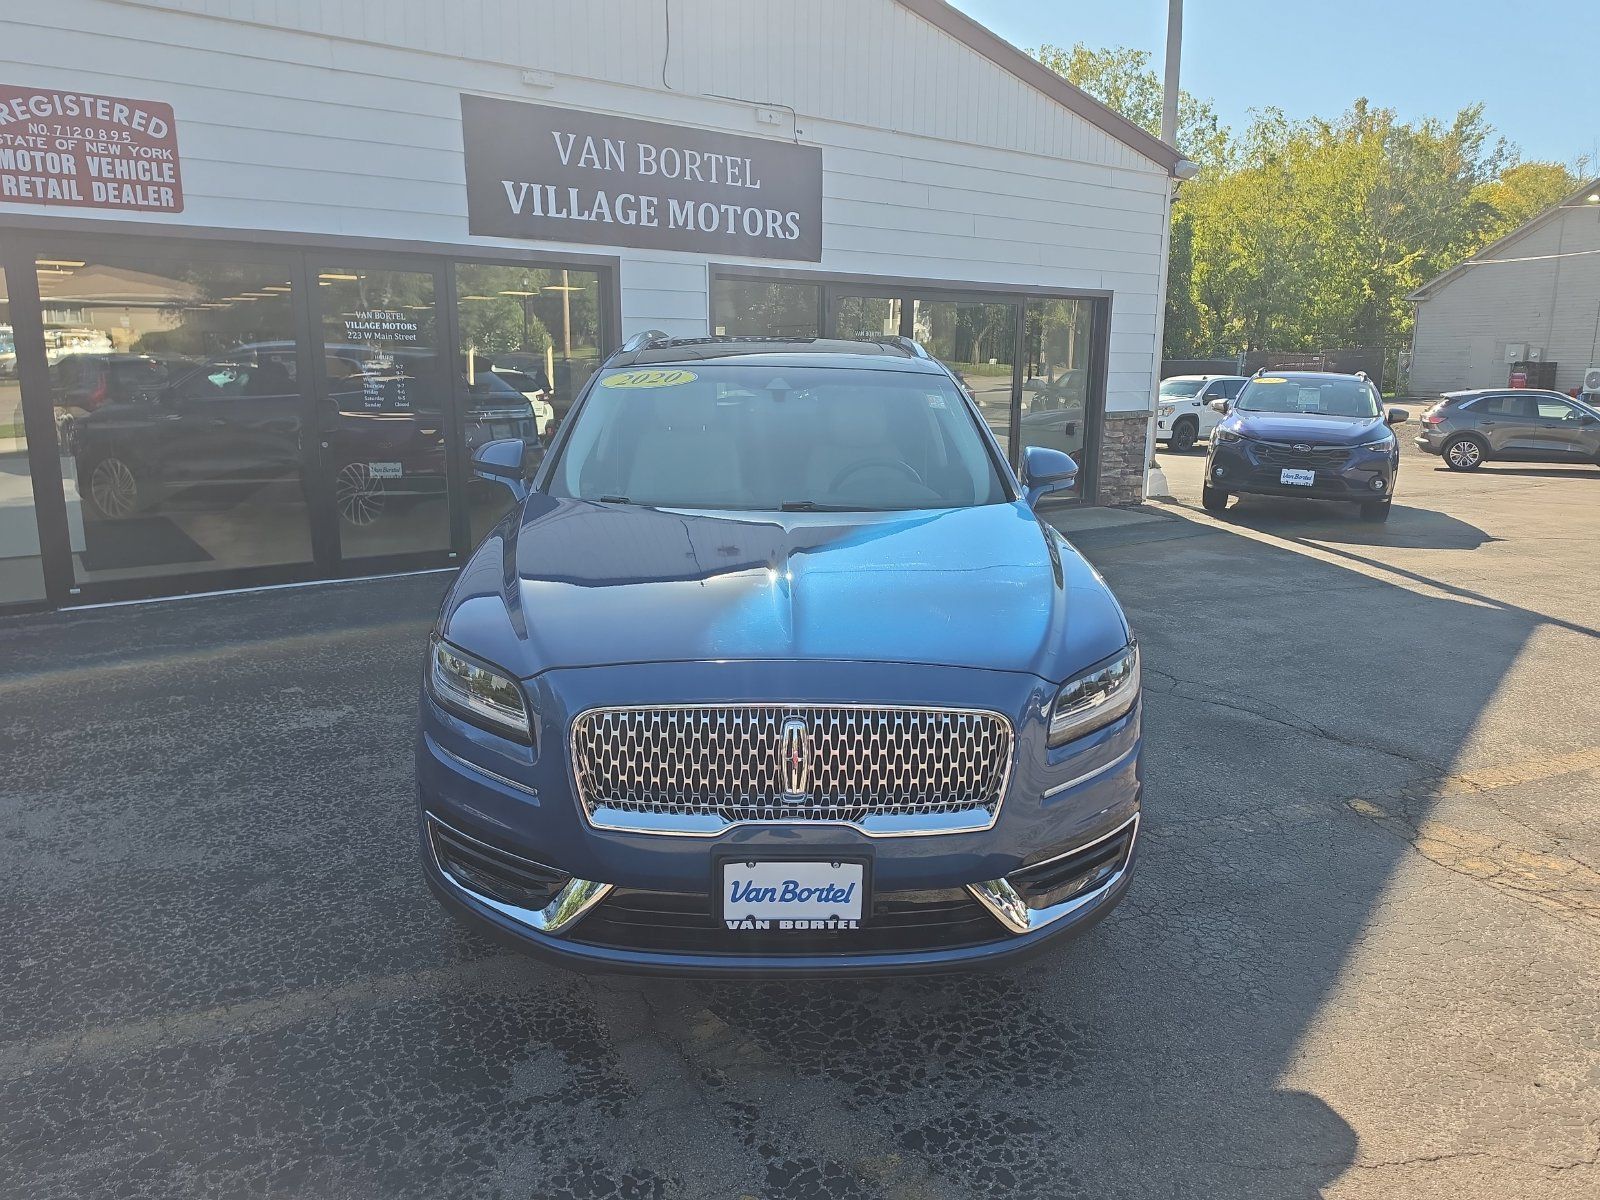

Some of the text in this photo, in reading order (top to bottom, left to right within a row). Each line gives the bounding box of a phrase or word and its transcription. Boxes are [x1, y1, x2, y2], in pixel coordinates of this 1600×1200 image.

[0, 95, 168, 139] REGISTERED
[53, 125, 131, 142] 7120895
[55, 140, 77, 151] OF
[86, 142, 121, 155] NEW
[128, 146, 173, 160] YORK
[551, 131, 760, 189] VAN BORTEL
[0, 149, 175, 183] MOTOR VEHICLE
[2, 175, 175, 207] RETAIL DEALER
[501, 181, 800, 240] VILLAGE MOTORS
[345, 321, 380, 329] VILLAGE
[355, 311, 406, 320] VAN BORTEL
[364, 332, 372, 340] W
[374, 332, 393, 340] Main
[394, 333, 417, 341] Street
[615, 373, 683, 385] 2020
[730, 879, 856, 904] Van Bortel
[725, 920, 860, 930] VAN BORTEL
